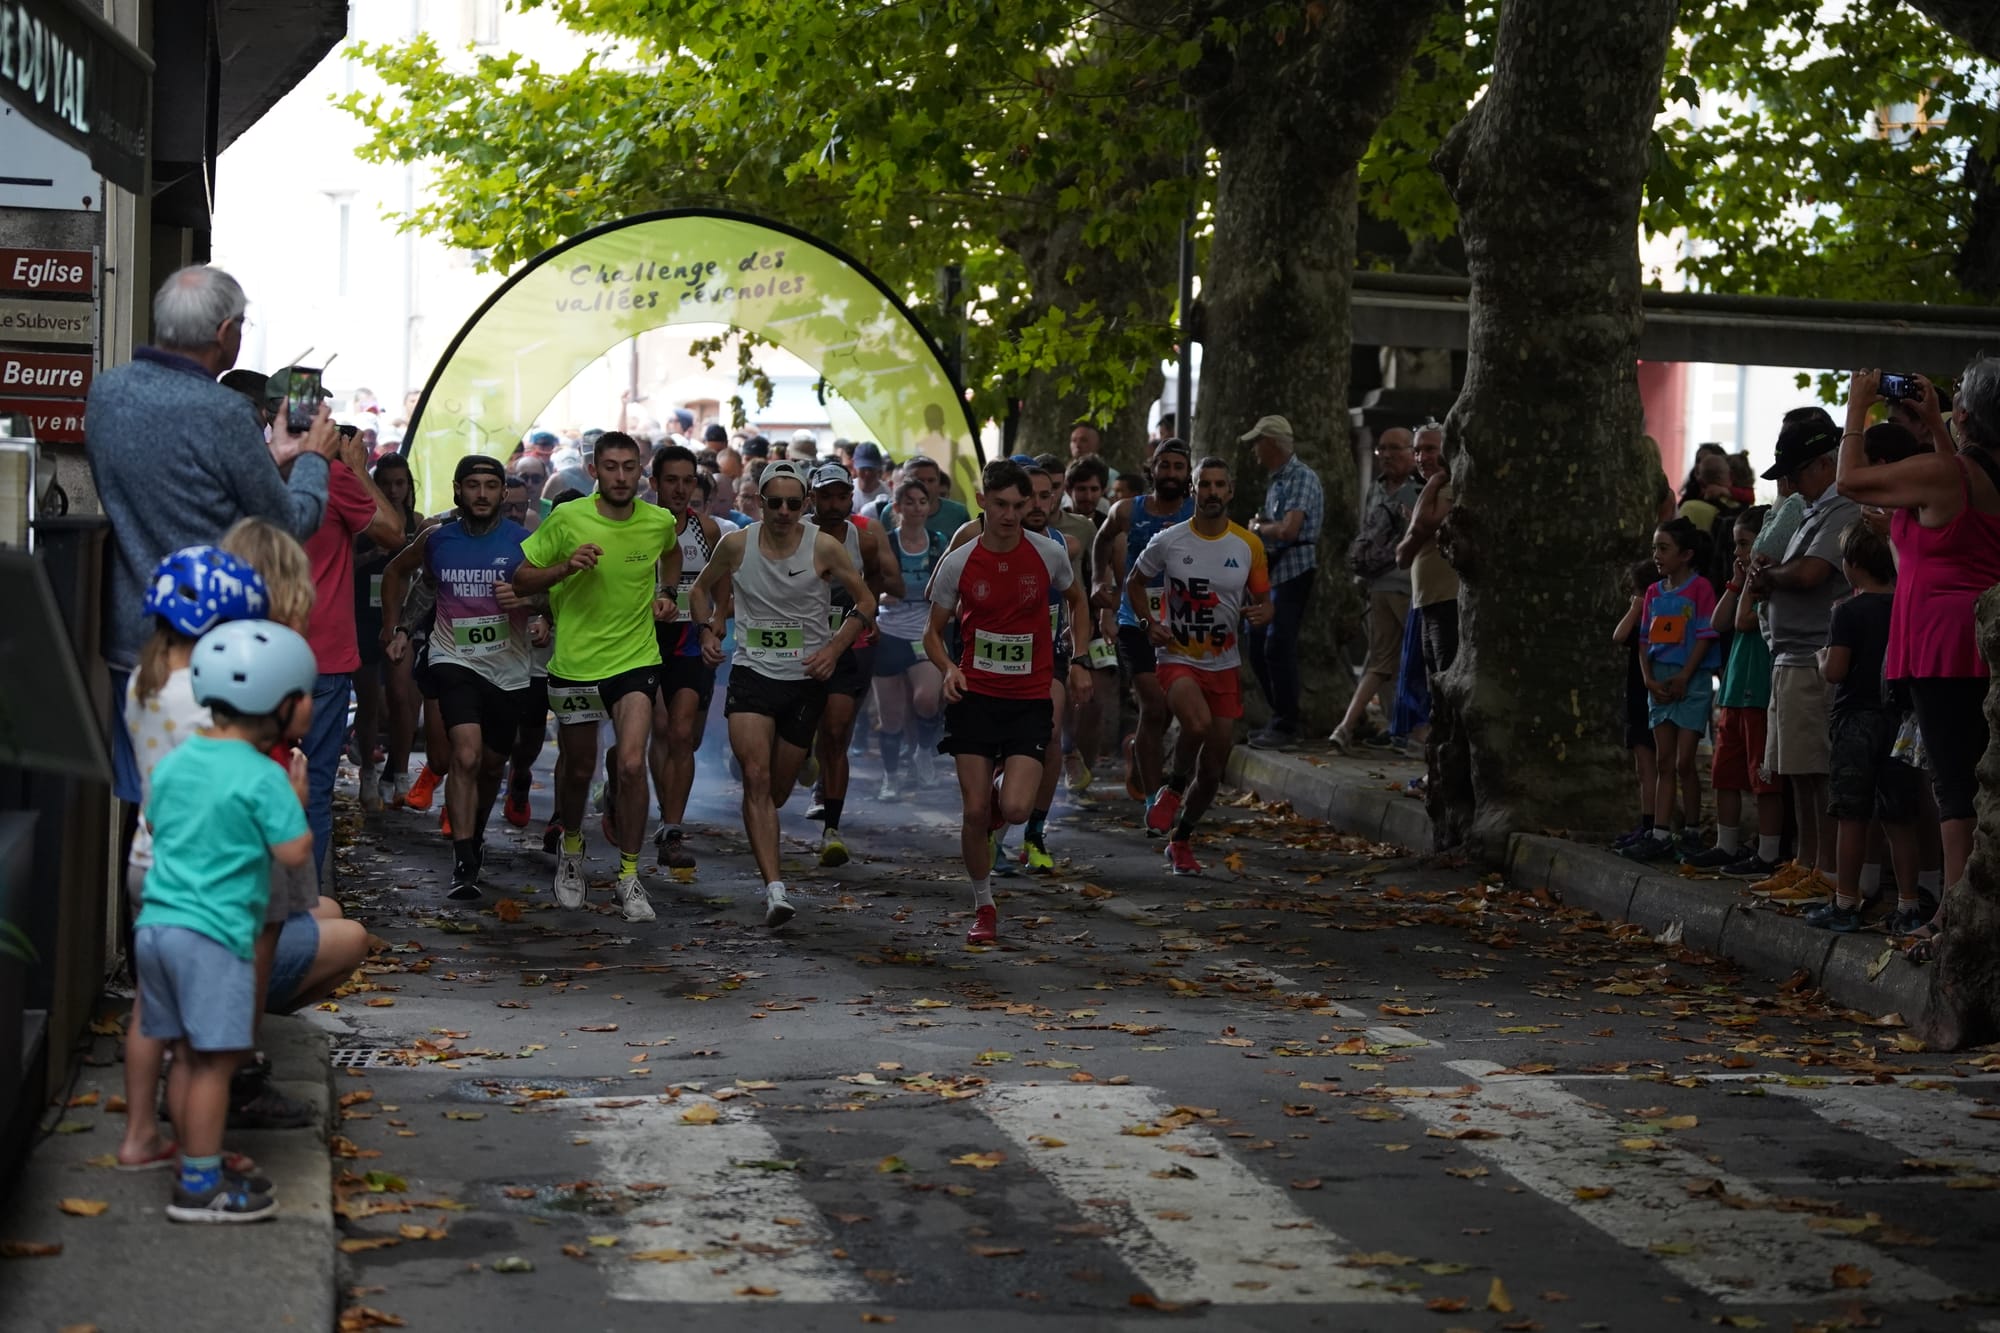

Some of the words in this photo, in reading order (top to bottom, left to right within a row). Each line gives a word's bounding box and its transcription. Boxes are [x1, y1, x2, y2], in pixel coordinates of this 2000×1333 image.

[13, 257, 84, 288] Eglise
[570, 258, 717, 286] Challenge
[738, 251, 785, 272] des
[556, 287, 659, 313] vallées
[680, 277, 806, 305] cévenoles
[3, 361, 84, 387] Beurre
[441, 568, 506, 584] MARVEJOLS
[453, 583, 493, 598] MENDE
[468, 626, 496, 644] 60
[1171, 623, 1227, 647] NTS
[1663, 621, 1672, 633] 4
[761, 631, 788, 648] 53
[983, 642, 1025, 661] 113
[563, 696, 590, 711] 43
